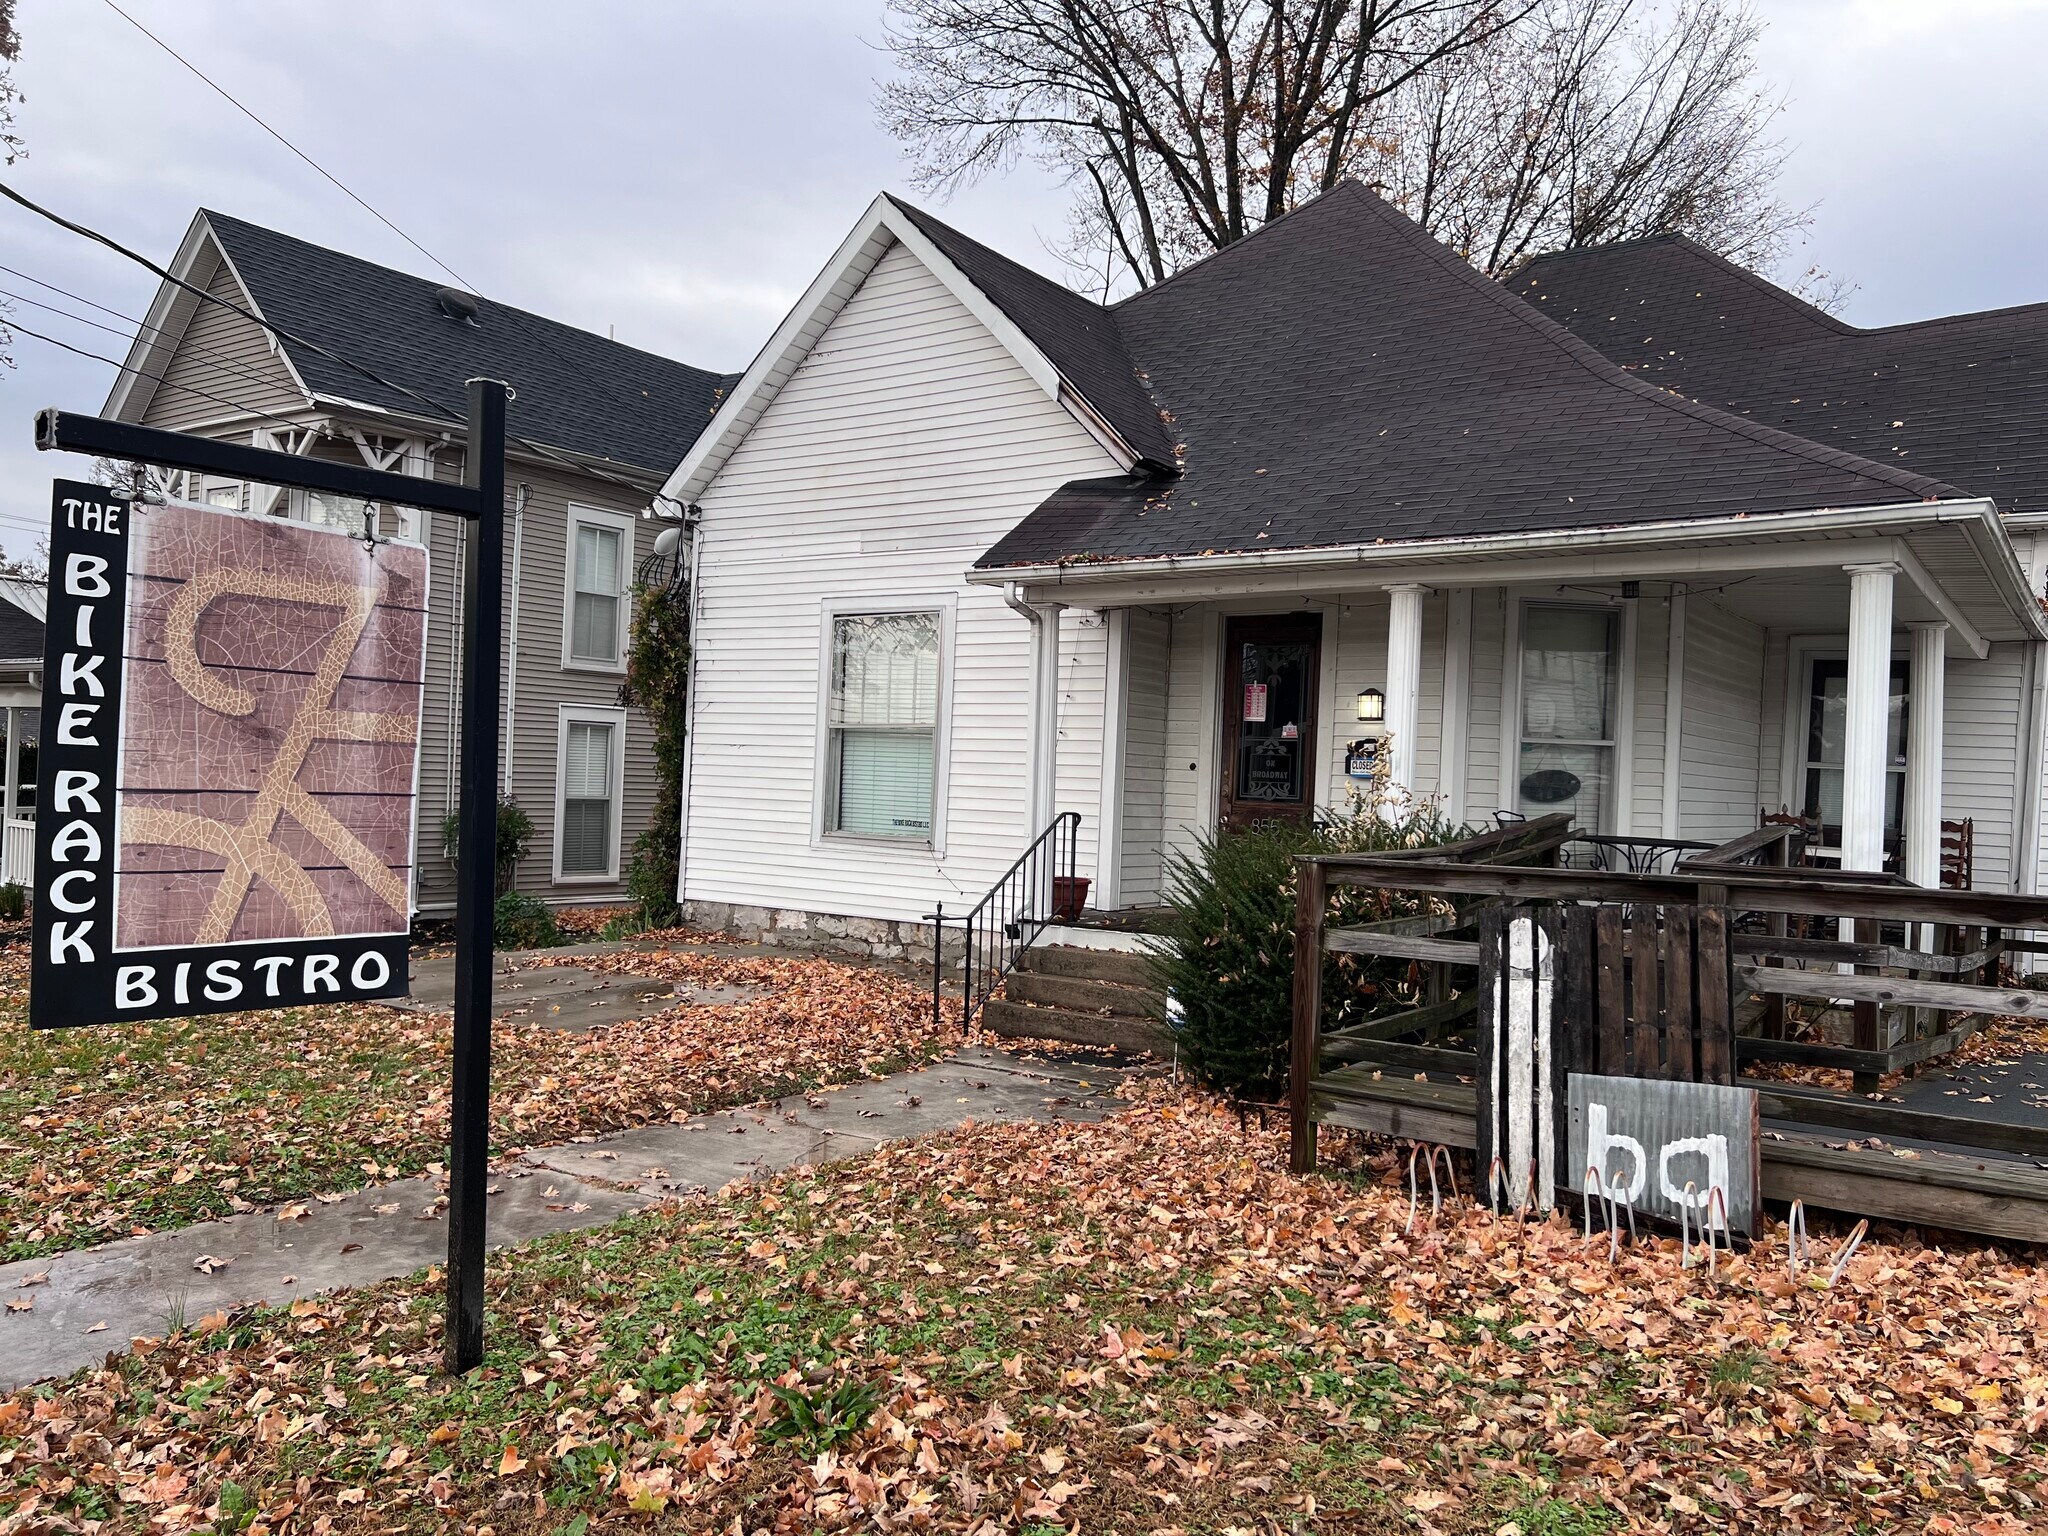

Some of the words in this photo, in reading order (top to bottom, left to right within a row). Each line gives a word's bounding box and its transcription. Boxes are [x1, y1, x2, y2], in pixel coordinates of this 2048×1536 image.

[61, 498, 122, 536] THE
[57, 552, 111, 748] BIKE
[1252, 770, 1288, 779] BROADWAY
[49, 769, 102, 966] RACK
[115, 949, 390, 1009] BISTRO
